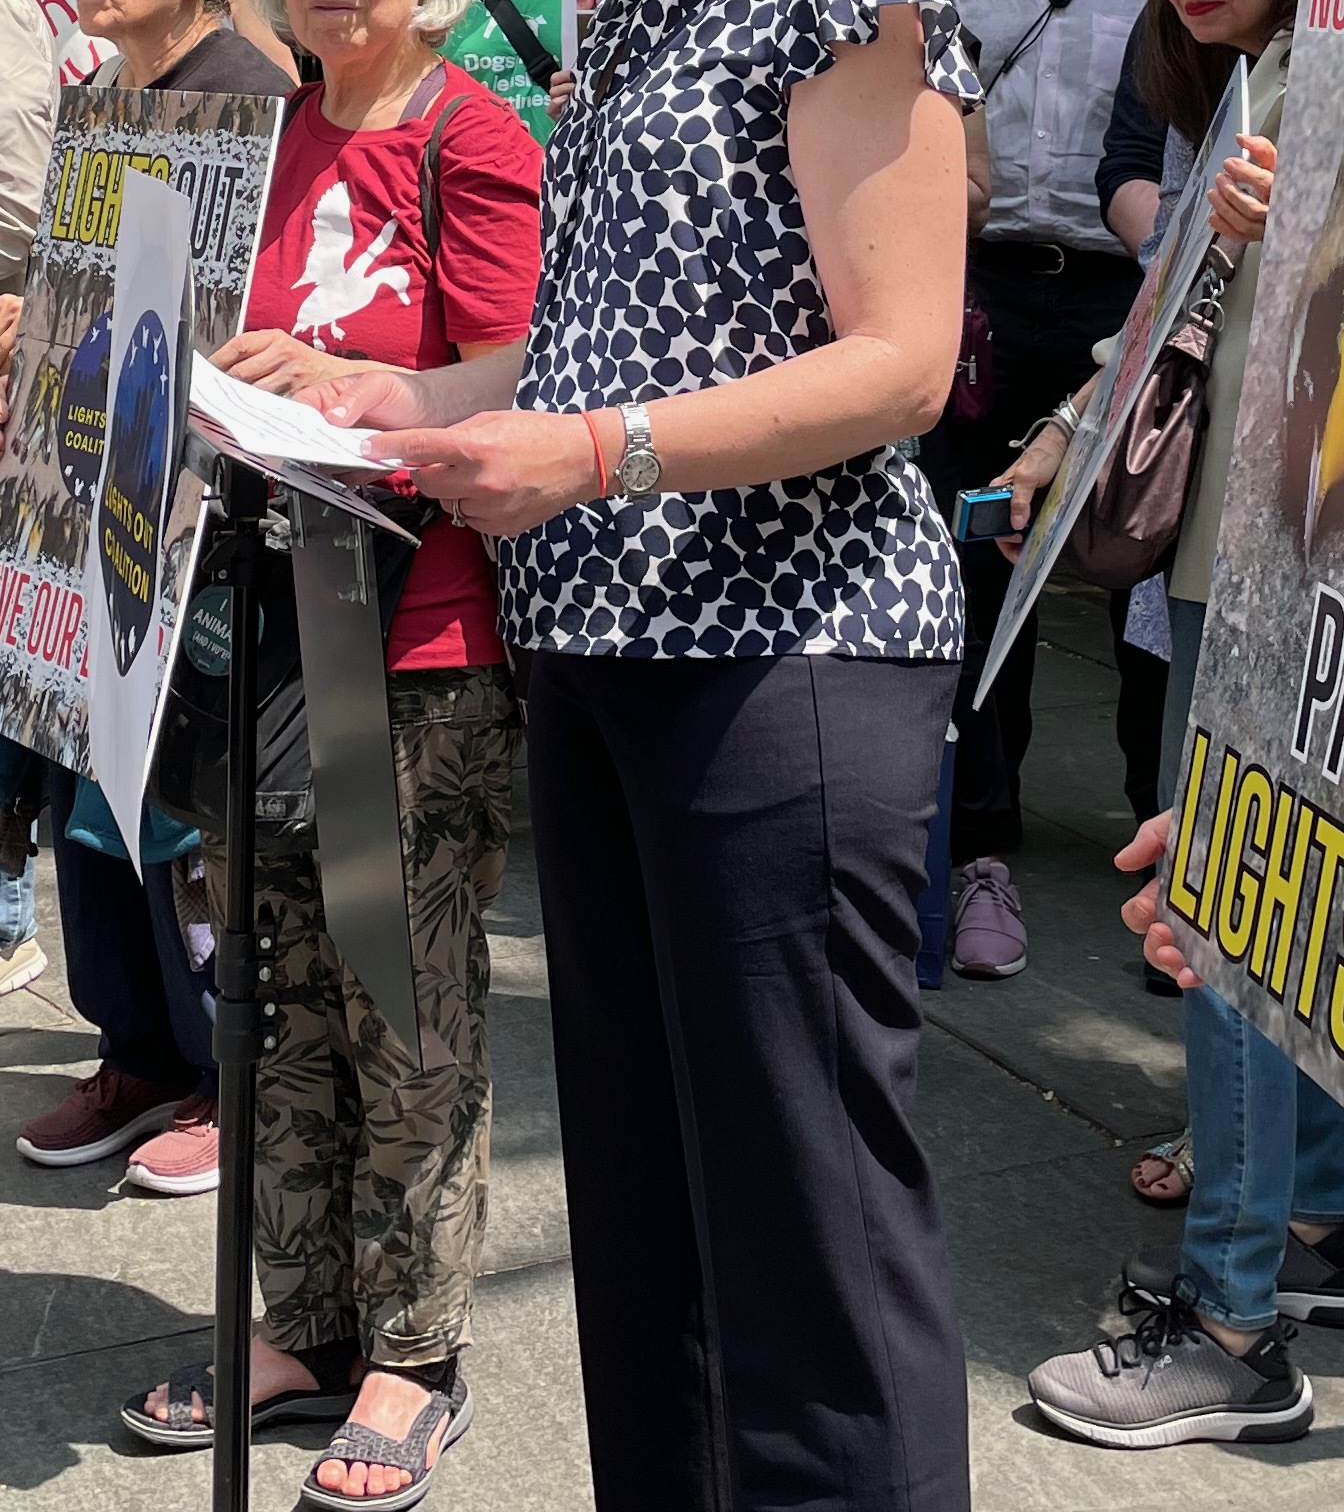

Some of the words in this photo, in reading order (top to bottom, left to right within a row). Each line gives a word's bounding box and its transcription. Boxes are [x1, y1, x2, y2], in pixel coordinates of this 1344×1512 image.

[464, 54, 515, 72] Dogs
[51, 146, 170, 248] LIGH
[68, 405, 106, 428] LIGHTS
[65, 430, 105, 455] COALIT
[104, 480, 133, 533] LIGHTS
[134, 512, 154, 554] OUT
[27, 582, 84, 670] OUR
[193, 609, 232, 643] ANIMA
